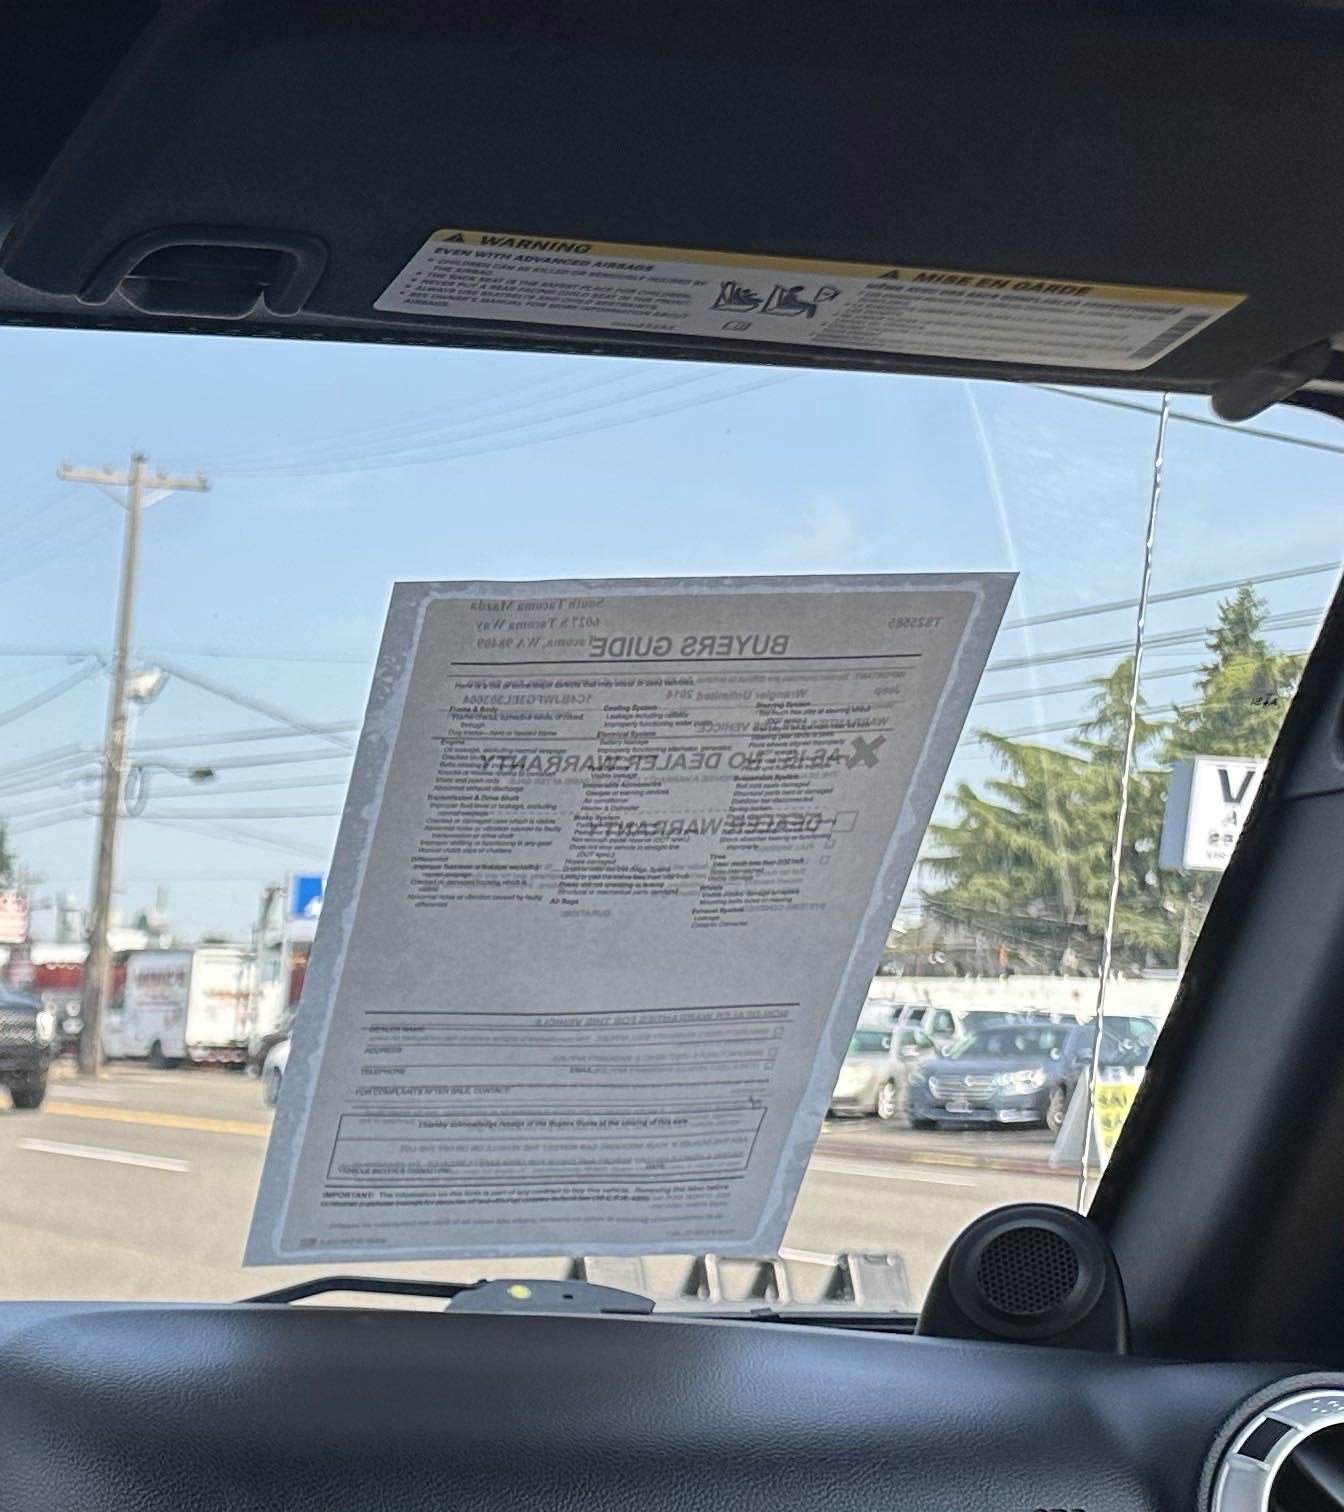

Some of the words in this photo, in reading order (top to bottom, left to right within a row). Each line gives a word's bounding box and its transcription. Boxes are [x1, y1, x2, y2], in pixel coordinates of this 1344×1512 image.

[480, 235, 592, 254] WARNING
[434, 247, 473, 256] EVEN
[475, 251, 513, 260] WITH
[514, 254, 591, 266] ADVANCED
[913, 271, 973, 286] MISE
[977, 277, 1009, 289] EN
[1012, 279, 1095, 297] GARDE
